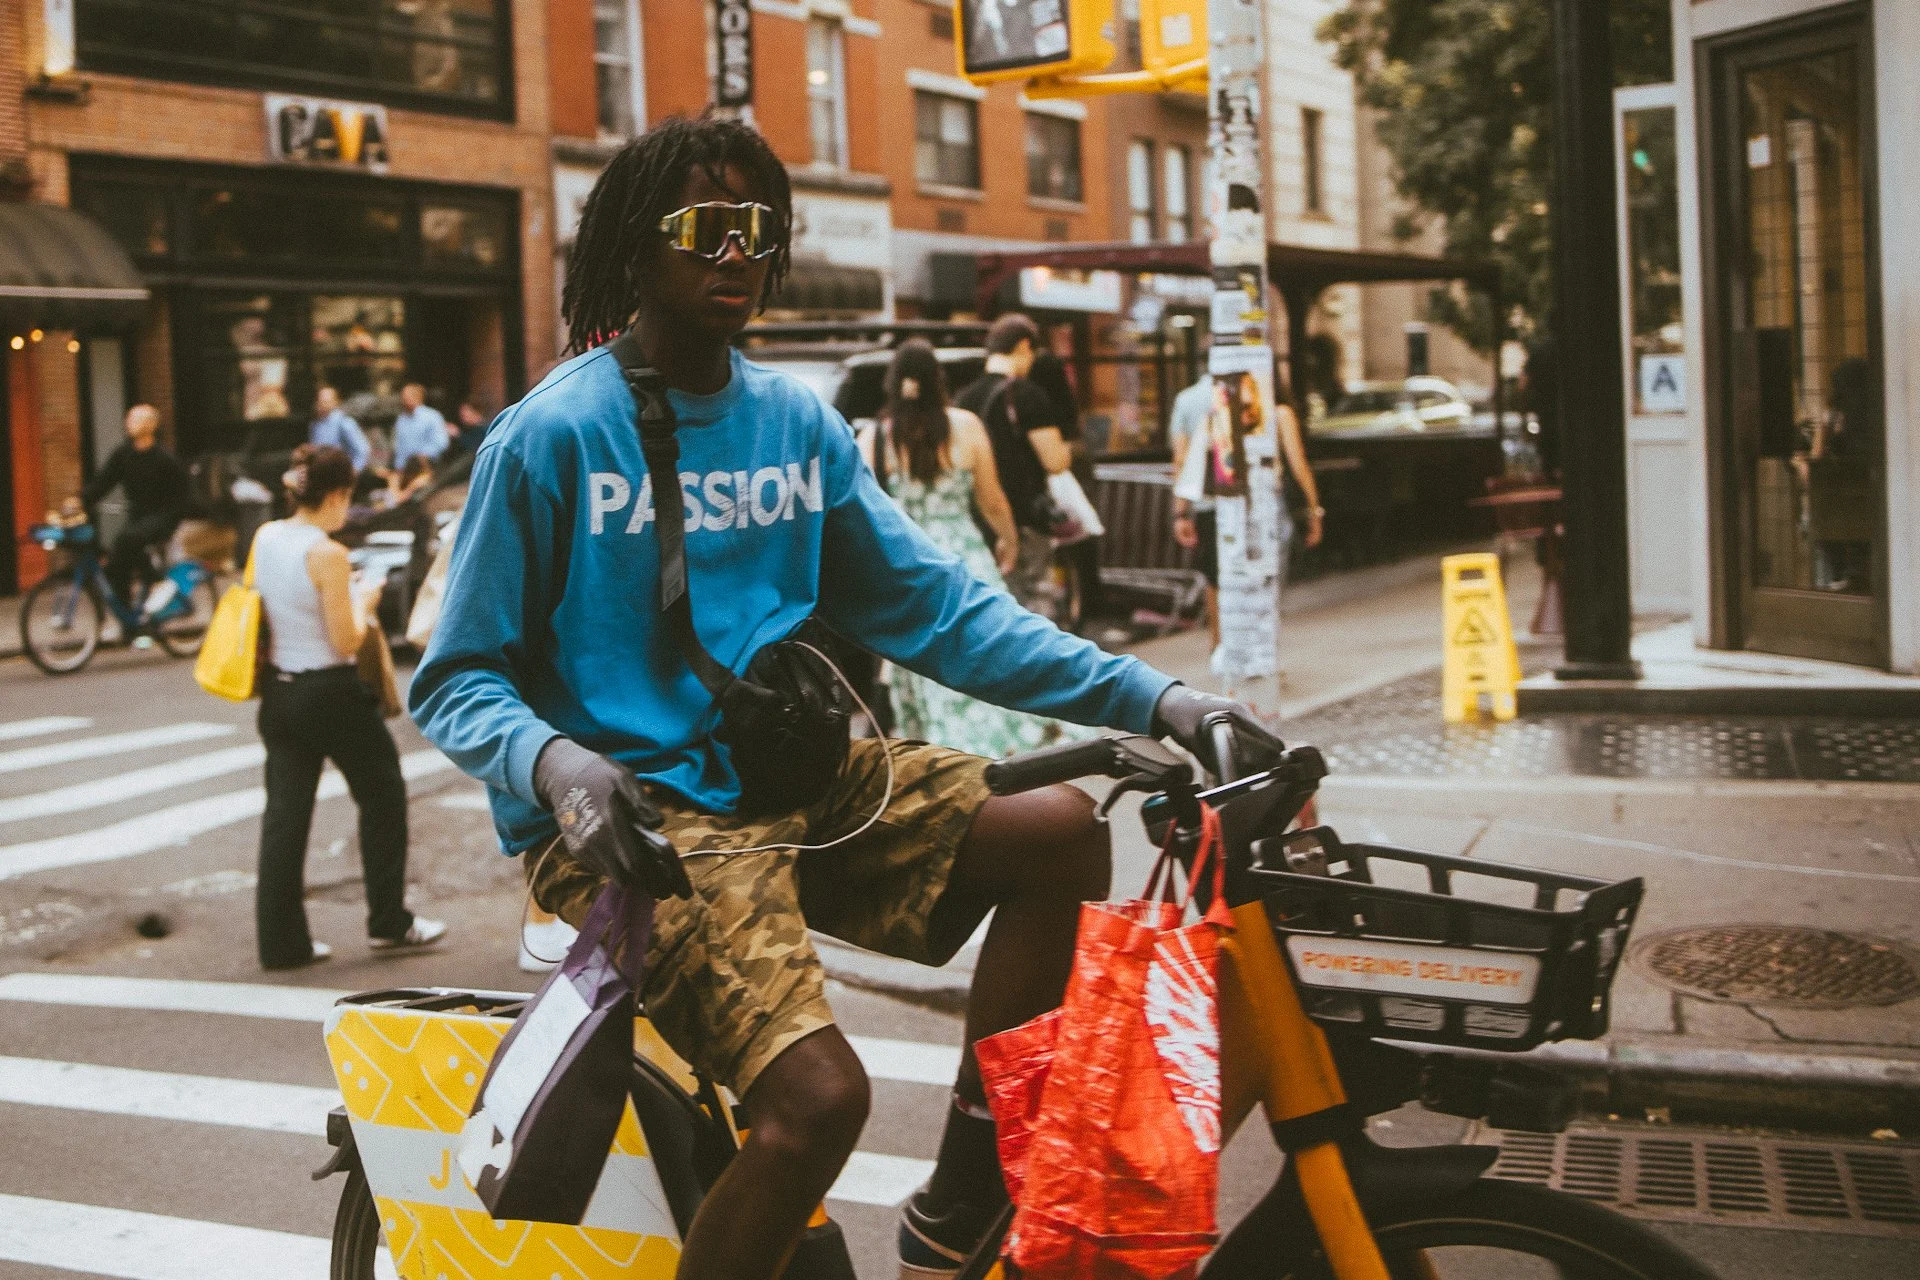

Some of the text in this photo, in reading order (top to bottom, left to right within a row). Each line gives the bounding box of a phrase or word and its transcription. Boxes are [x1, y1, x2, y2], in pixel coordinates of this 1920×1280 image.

[1651, 364, 1677, 393] A
[589, 457, 823, 534] PASSION
[1302, 951, 1523, 986] POWERING DELIVERY
